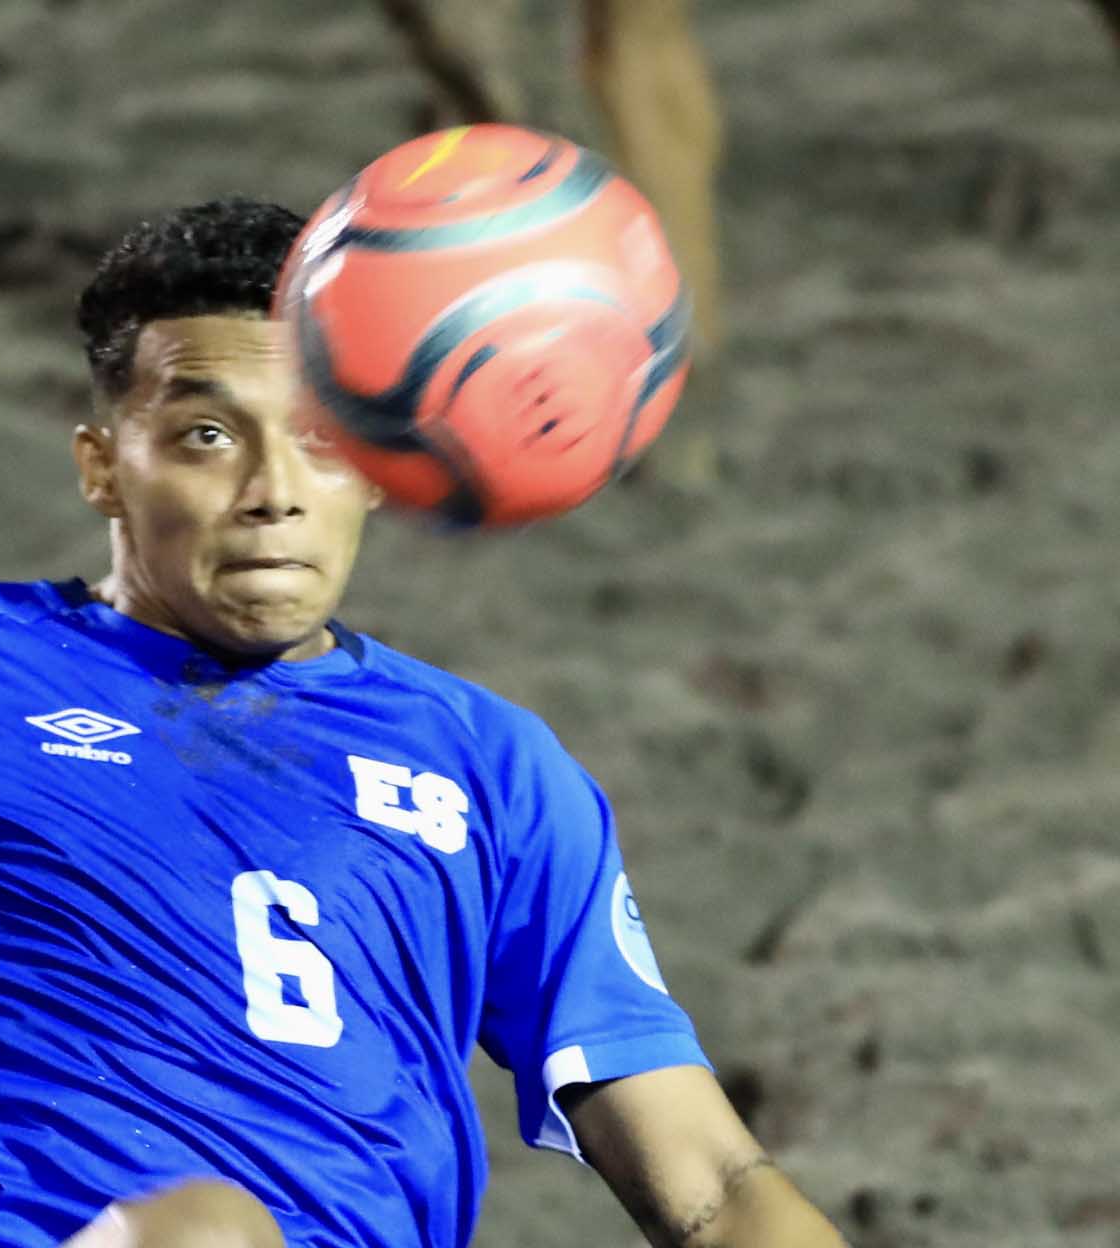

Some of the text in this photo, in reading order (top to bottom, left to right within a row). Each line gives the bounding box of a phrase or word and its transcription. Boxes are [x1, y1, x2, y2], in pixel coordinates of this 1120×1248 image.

[41, 742, 132, 765] umbro
[347, 754, 469, 855] ES
[231, 870, 343, 1047] 6
